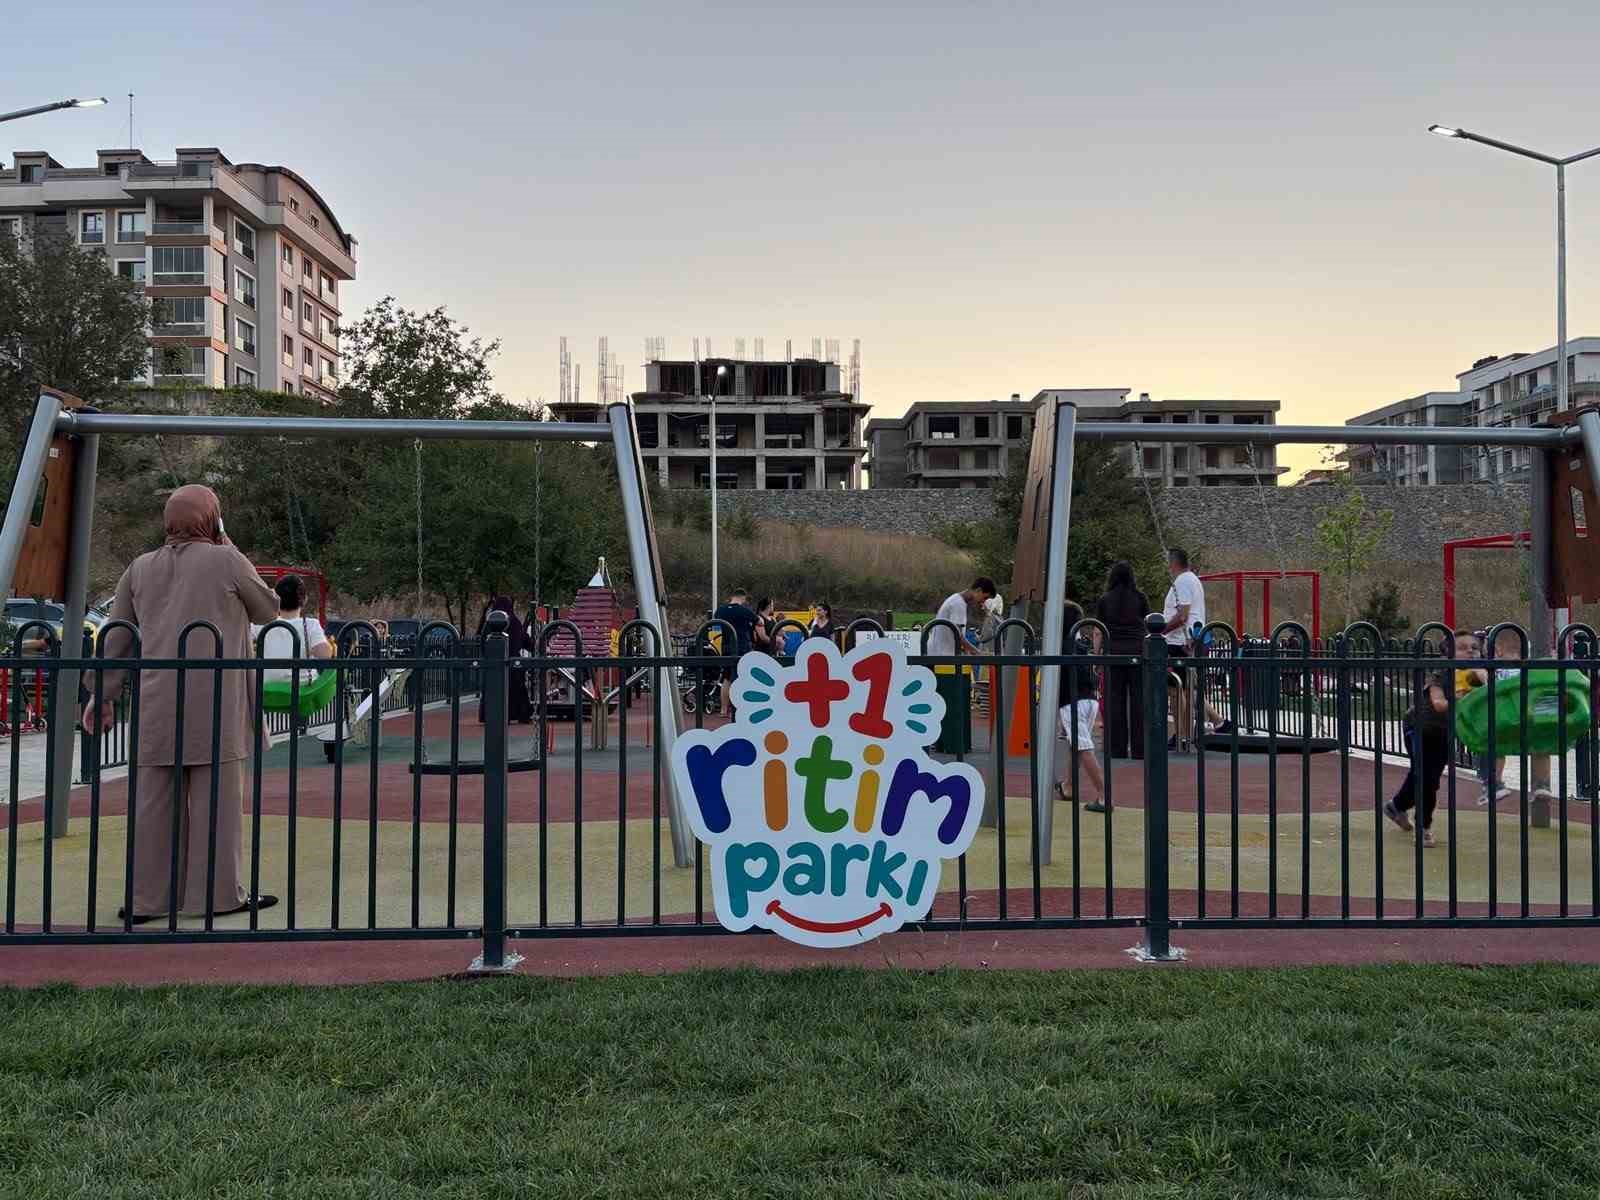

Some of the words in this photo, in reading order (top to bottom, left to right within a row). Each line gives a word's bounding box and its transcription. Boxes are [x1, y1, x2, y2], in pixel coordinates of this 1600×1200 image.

[784, 652, 893, 739] +1
[686, 730, 971, 845] ritim
[725, 840, 929, 918] parkı
